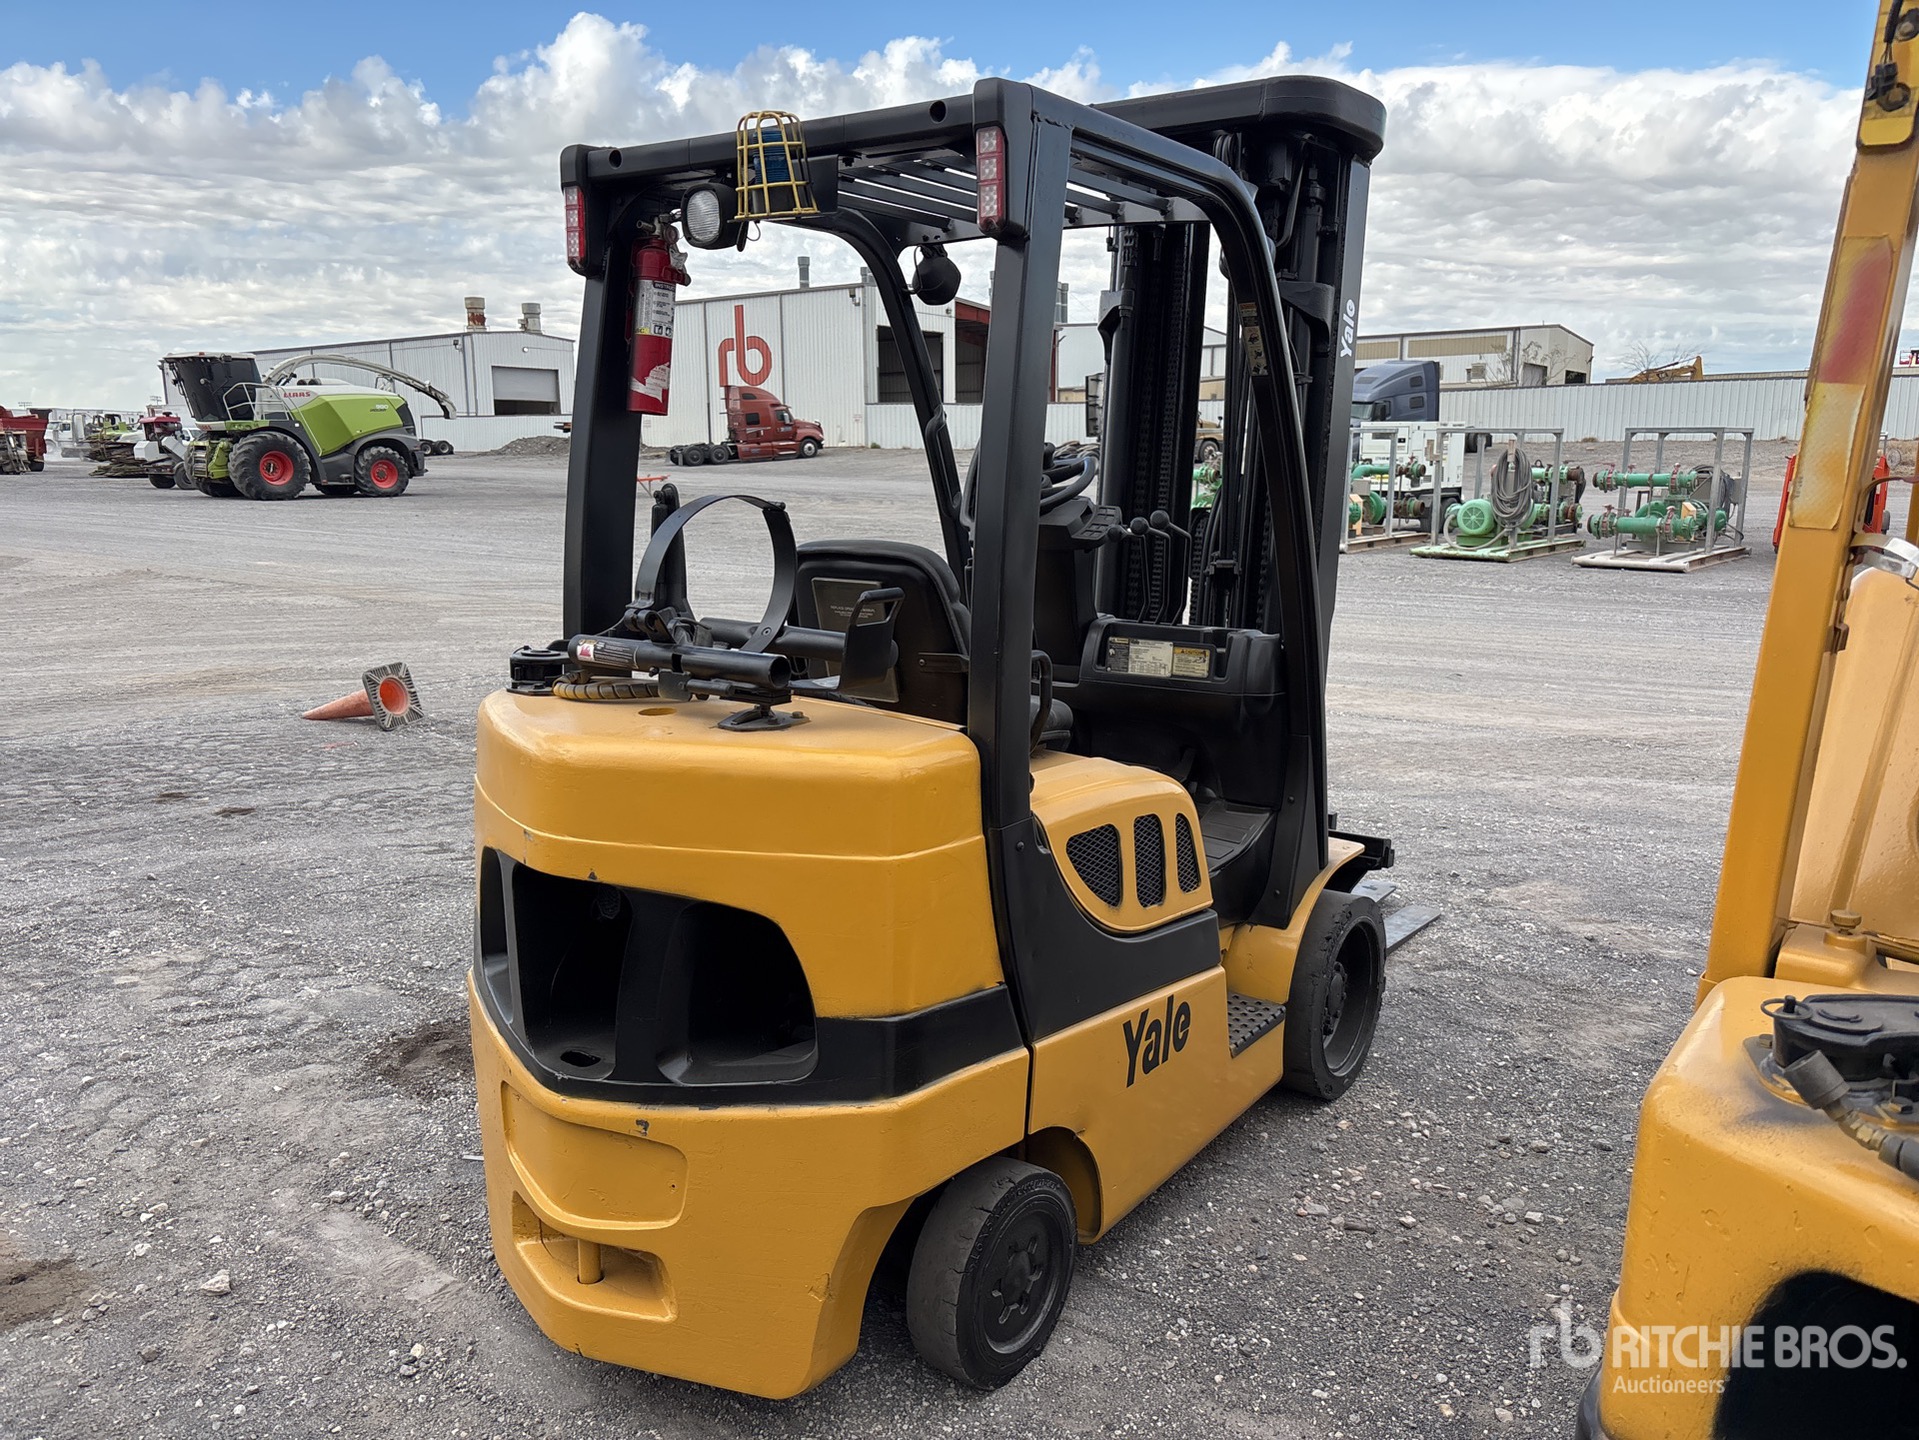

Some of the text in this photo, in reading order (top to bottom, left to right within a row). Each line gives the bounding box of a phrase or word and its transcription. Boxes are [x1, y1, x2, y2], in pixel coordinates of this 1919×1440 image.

[718, 304, 772, 388] rb
[1340, 299, 1355, 357] Yale
[1123, 993, 1191, 1088] Yale
